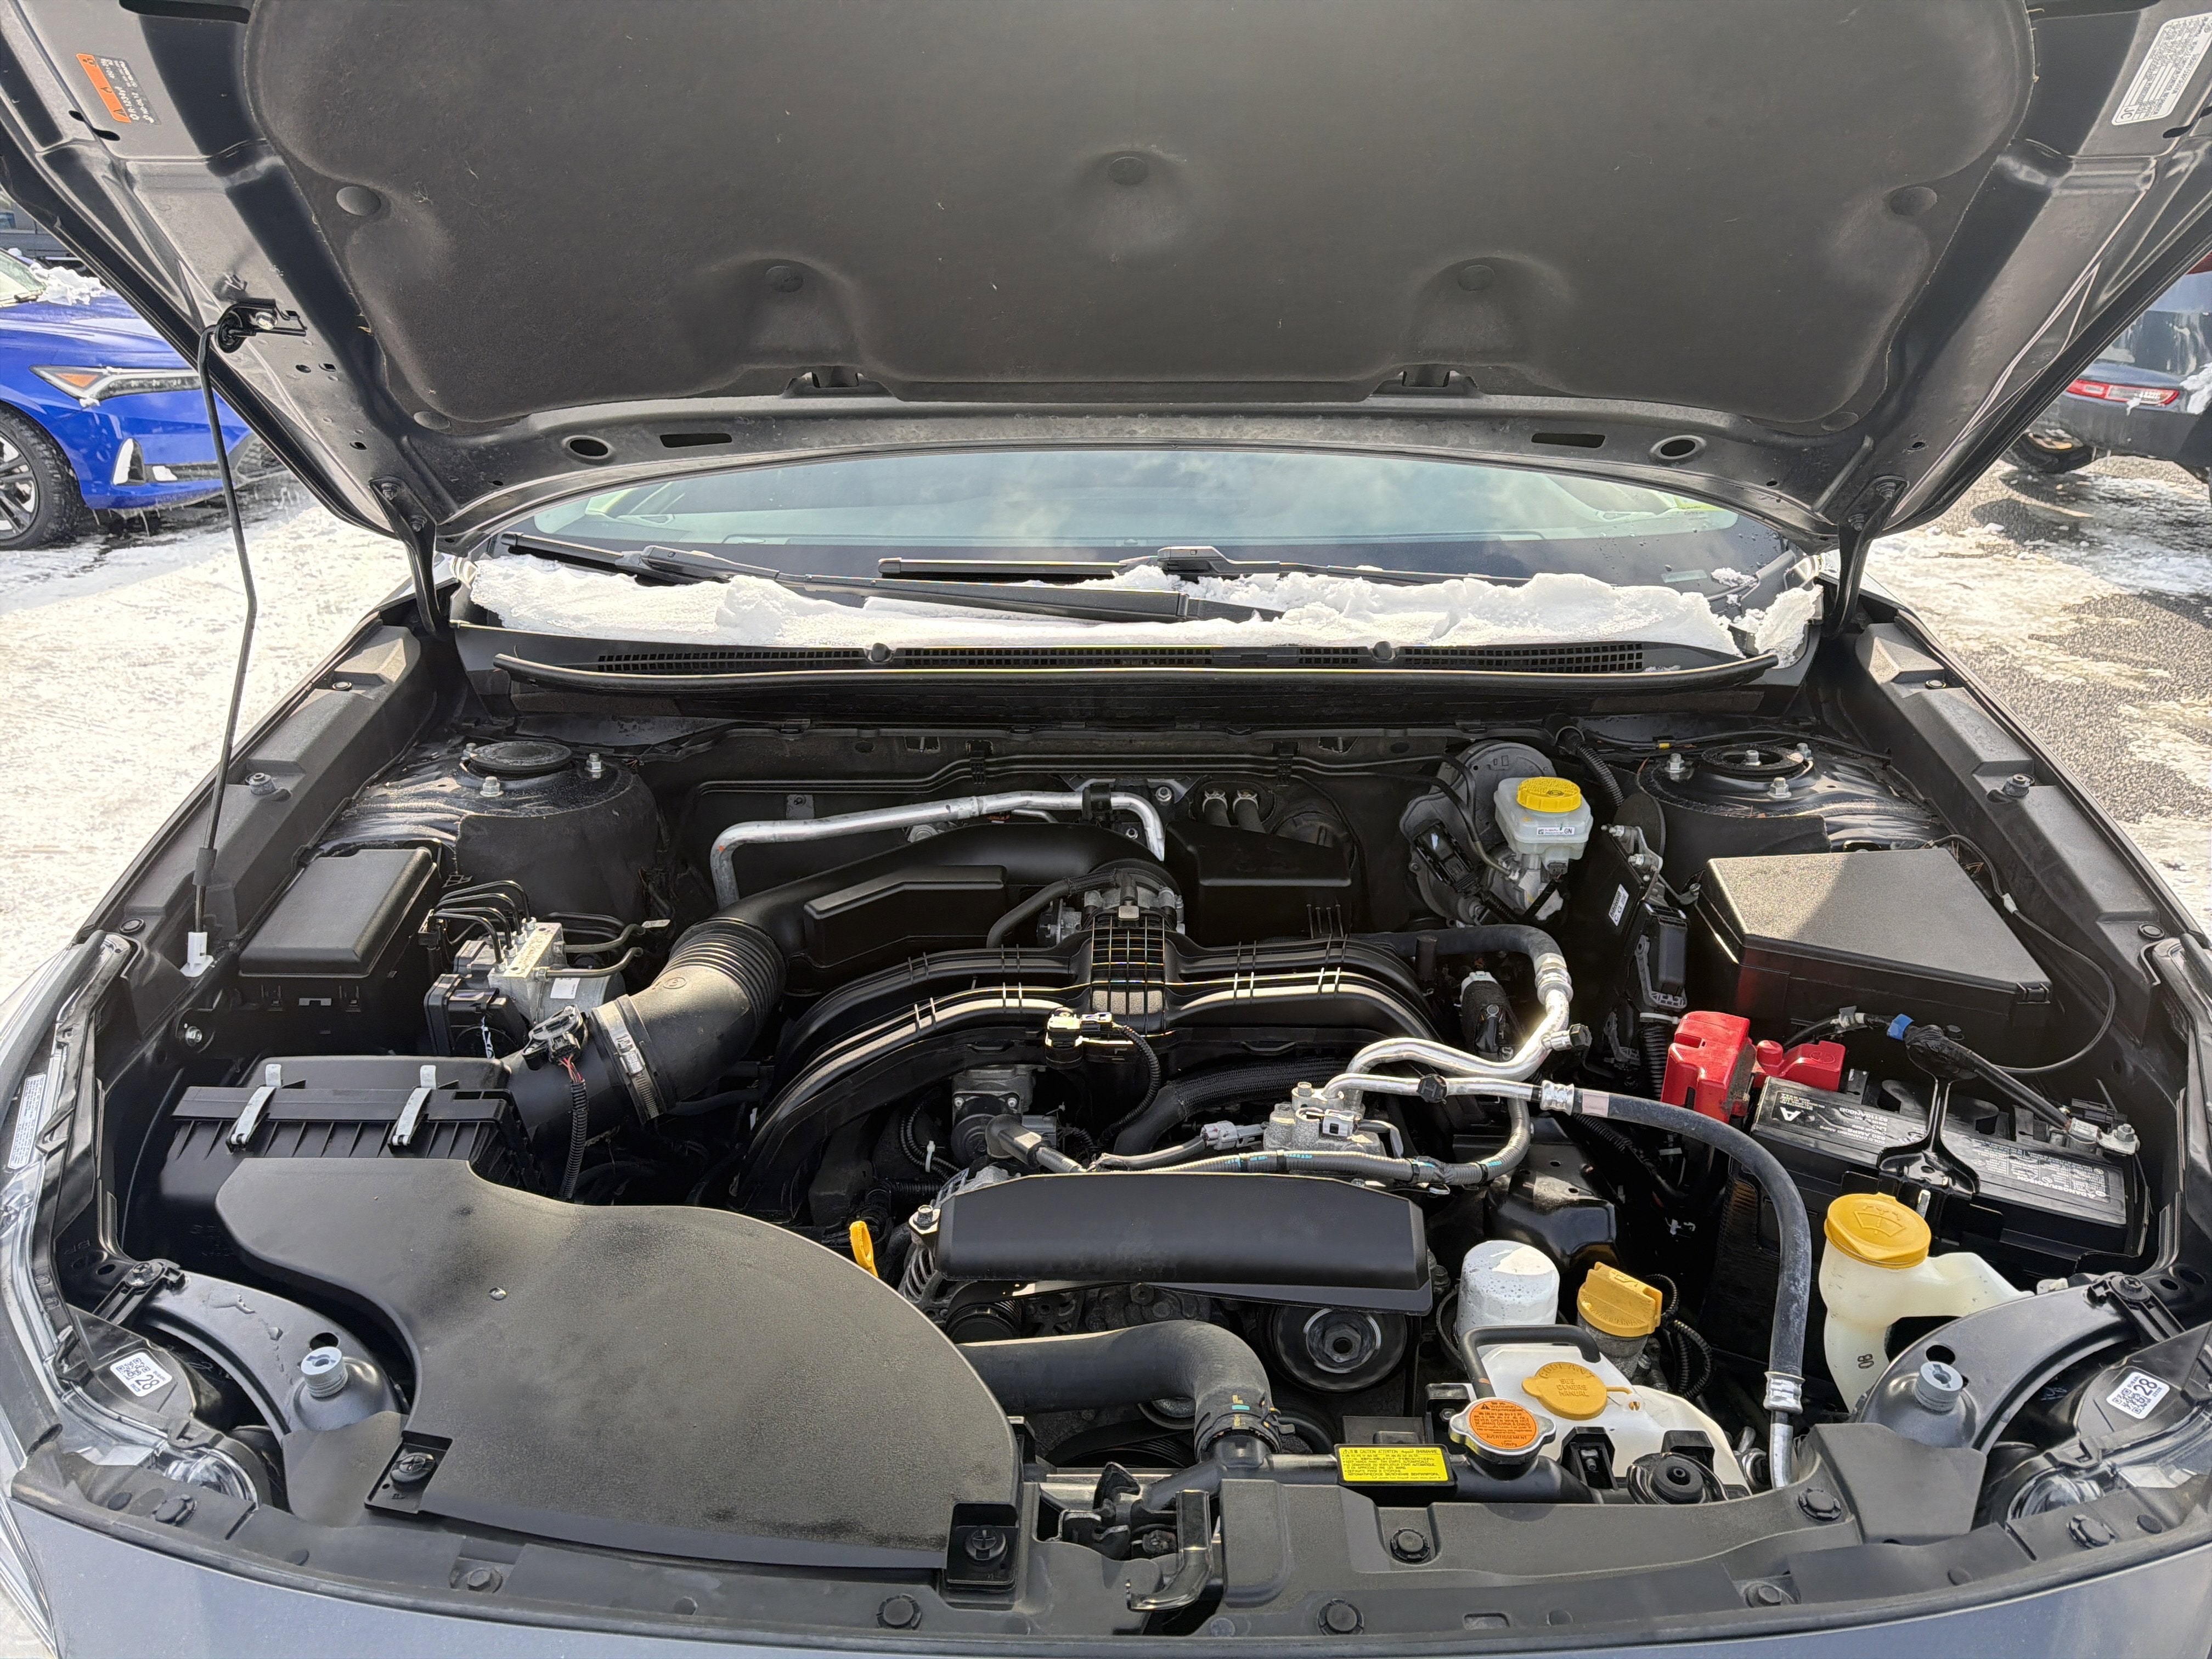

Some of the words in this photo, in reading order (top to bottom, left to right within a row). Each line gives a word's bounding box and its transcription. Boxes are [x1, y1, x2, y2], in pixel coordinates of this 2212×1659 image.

[2120, 108, 2135, 119] JC
[1421, 1081, 1437, 1098] H
[1848, 1128, 1870, 1137] AMPS
[1539, 1363, 1595, 1379] COOLANT
[135, 1374, 160, 1390] 28
[2133, 1378, 2158, 1396] 28
